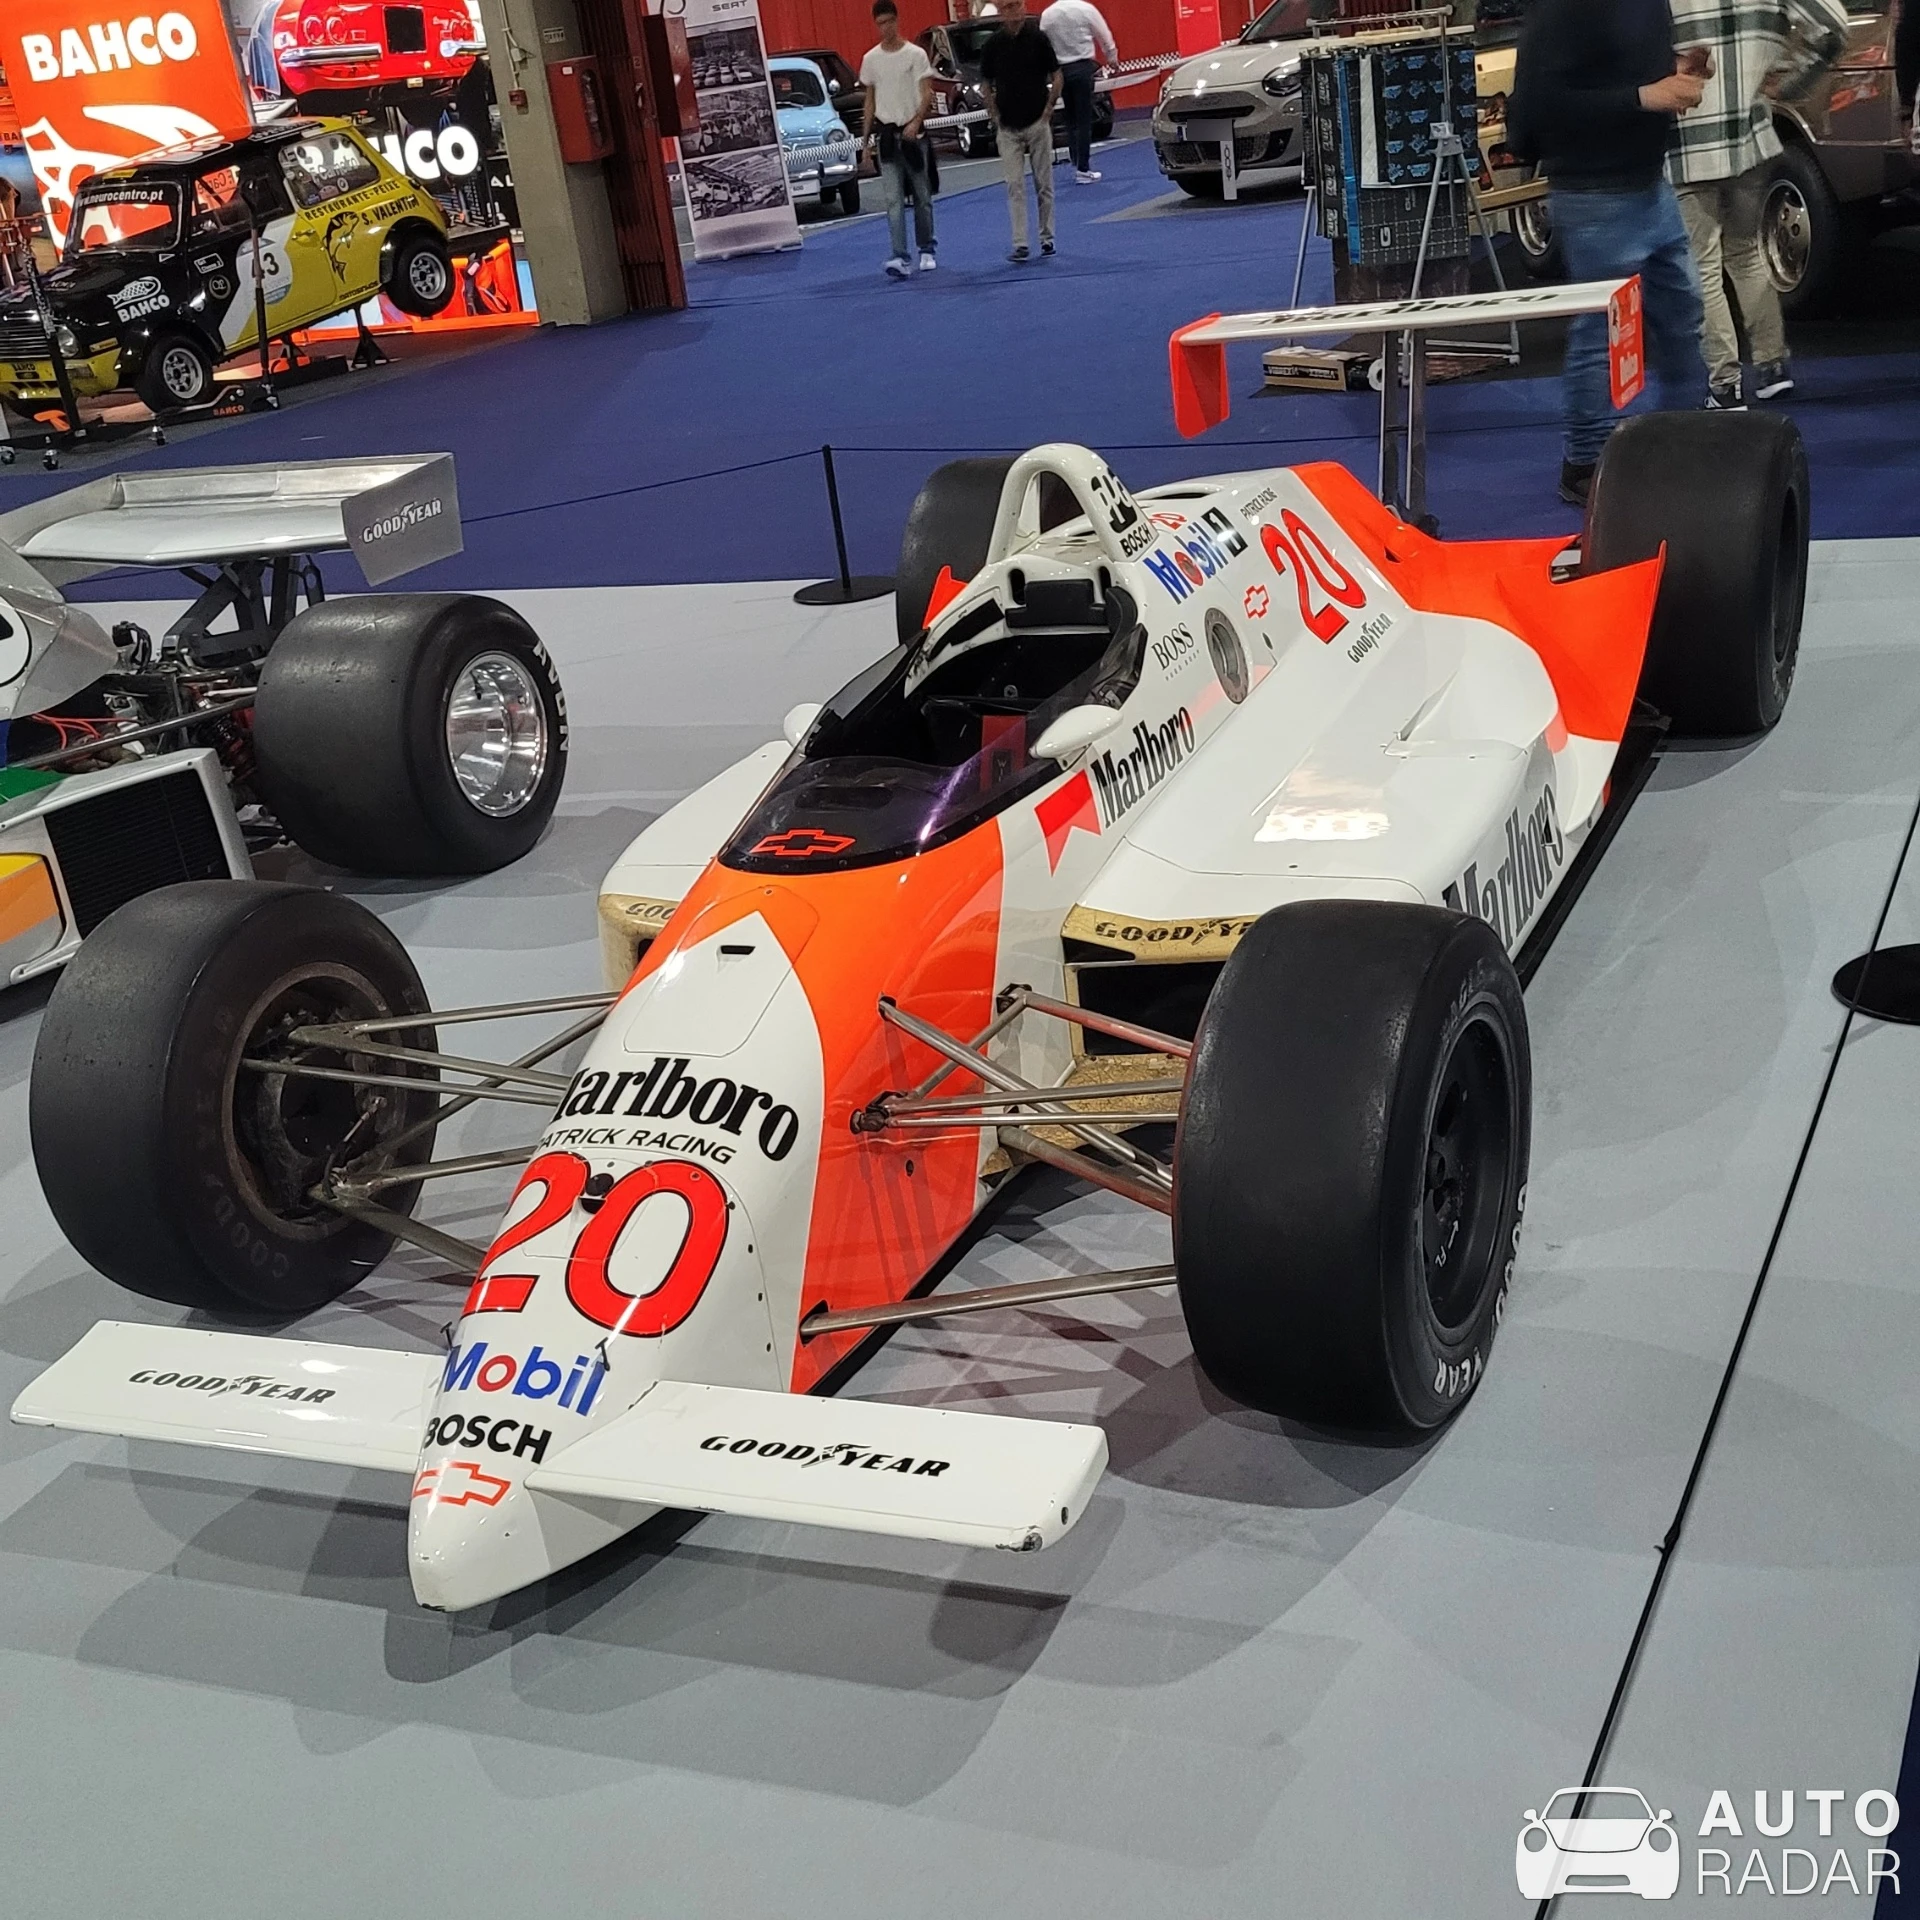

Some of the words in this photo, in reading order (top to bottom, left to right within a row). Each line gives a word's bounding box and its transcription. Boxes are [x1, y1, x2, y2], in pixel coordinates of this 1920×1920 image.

[712, 1, 748, 12] SEAT
[21, 12, 198, 82] BAHCO
[117, 294, 170, 323] BAHCO
[213, 405, 244, 416] BAHCO
[1119, 522, 1154, 558] BOSCH
[1143, 521, 1229, 605] Mobil
[1260, 508, 1367, 645] 20
[1151, 622, 1194, 670] BOSS
[1091, 705, 1196, 829] Marlboro
[625, 1128, 737, 1165] RACING
[463, 1151, 730, 1339] 20
[443, 1341, 608, 1417] Mobil
[423, 1413, 552, 1465] BOSCH
